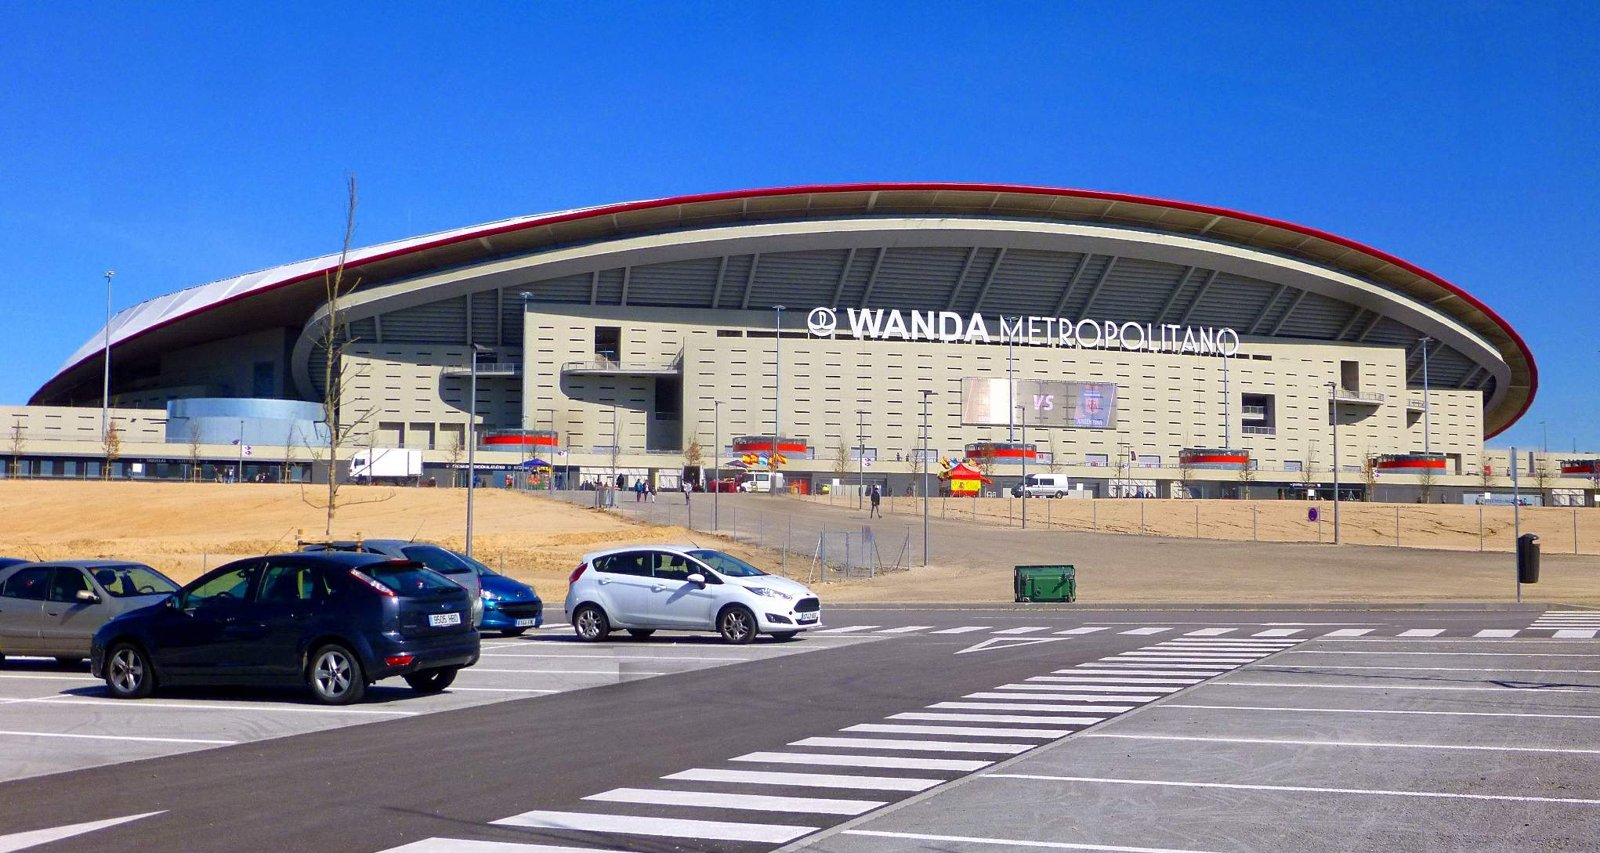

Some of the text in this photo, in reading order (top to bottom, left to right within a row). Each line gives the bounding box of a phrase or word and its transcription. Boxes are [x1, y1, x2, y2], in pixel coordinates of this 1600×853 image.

[847, 307, 1240, 356] WANDA METROPOLITANO
[1033, 394, 1055, 411] VS
